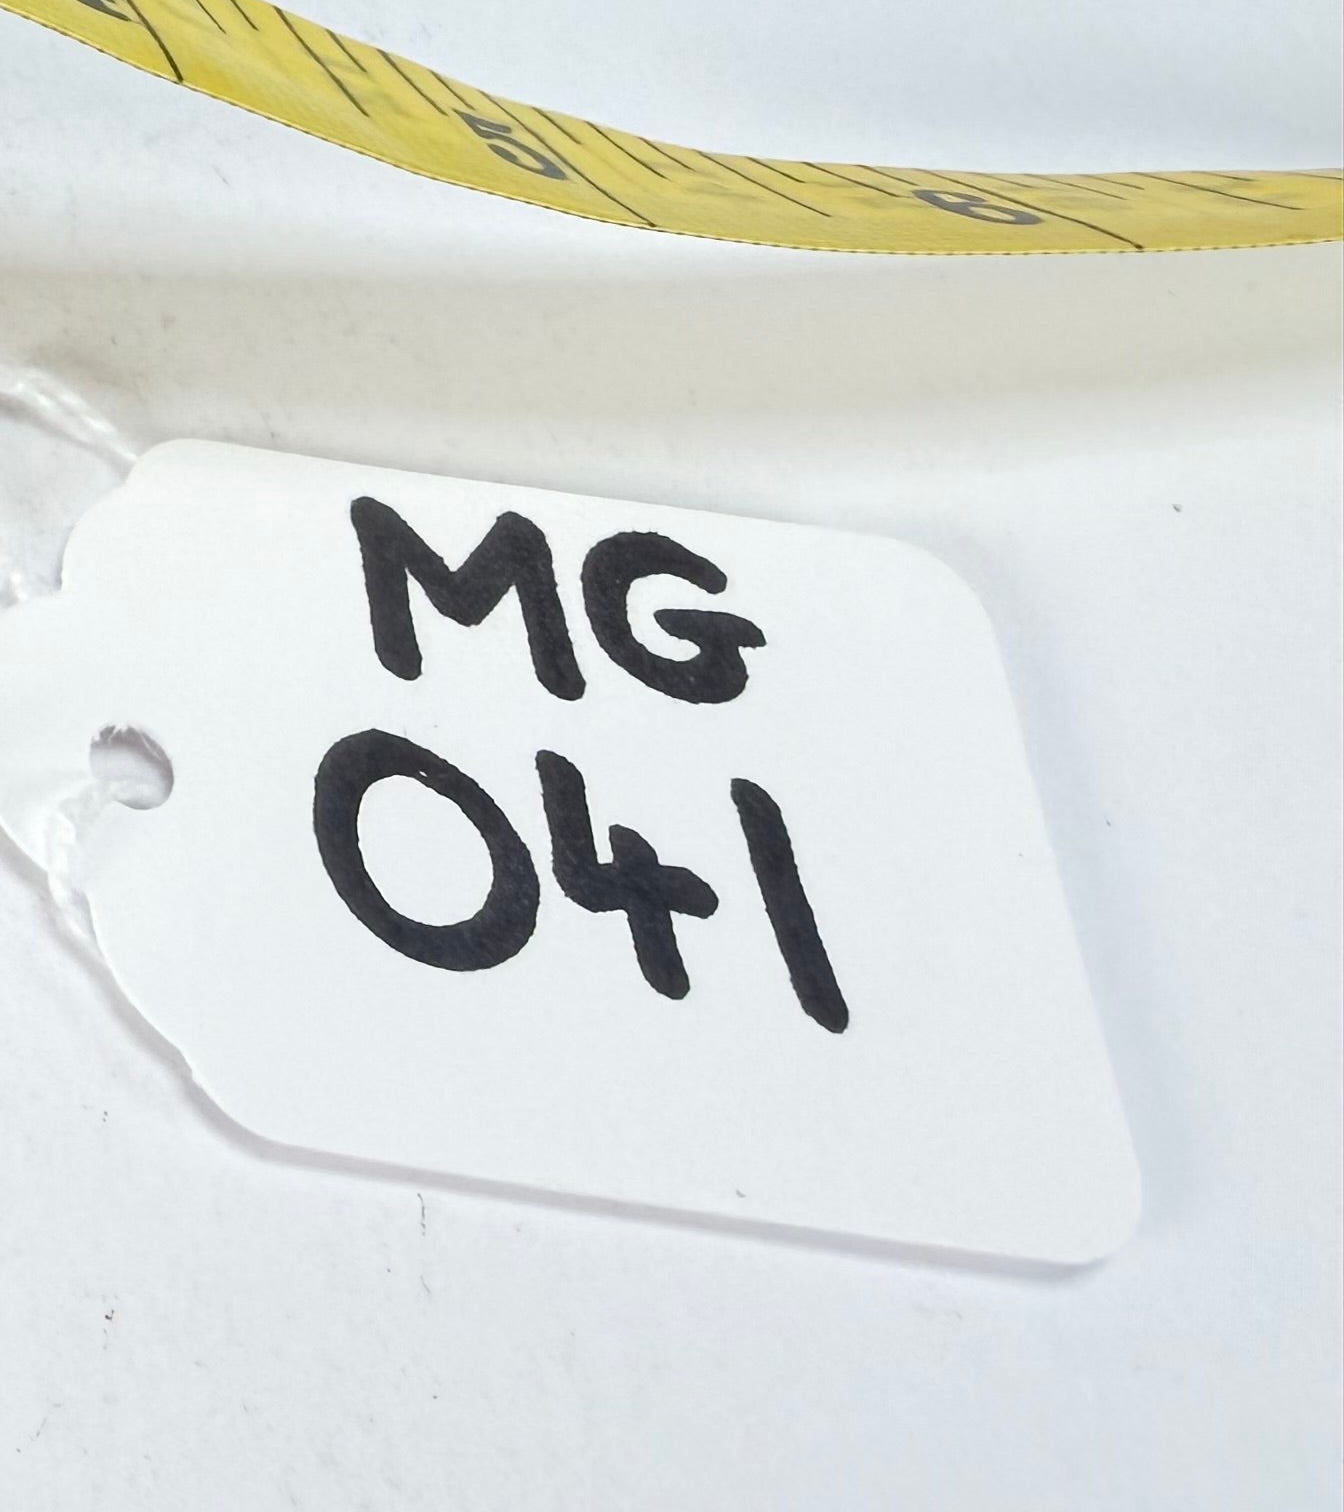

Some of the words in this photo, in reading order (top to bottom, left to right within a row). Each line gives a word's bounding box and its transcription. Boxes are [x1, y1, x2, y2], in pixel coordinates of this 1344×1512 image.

[456, 109, 567, 181] 5
[910, 188, 1043, 226] 6
[349, 495, 767, 705] MG
[312, 728, 850, 1034] 041
